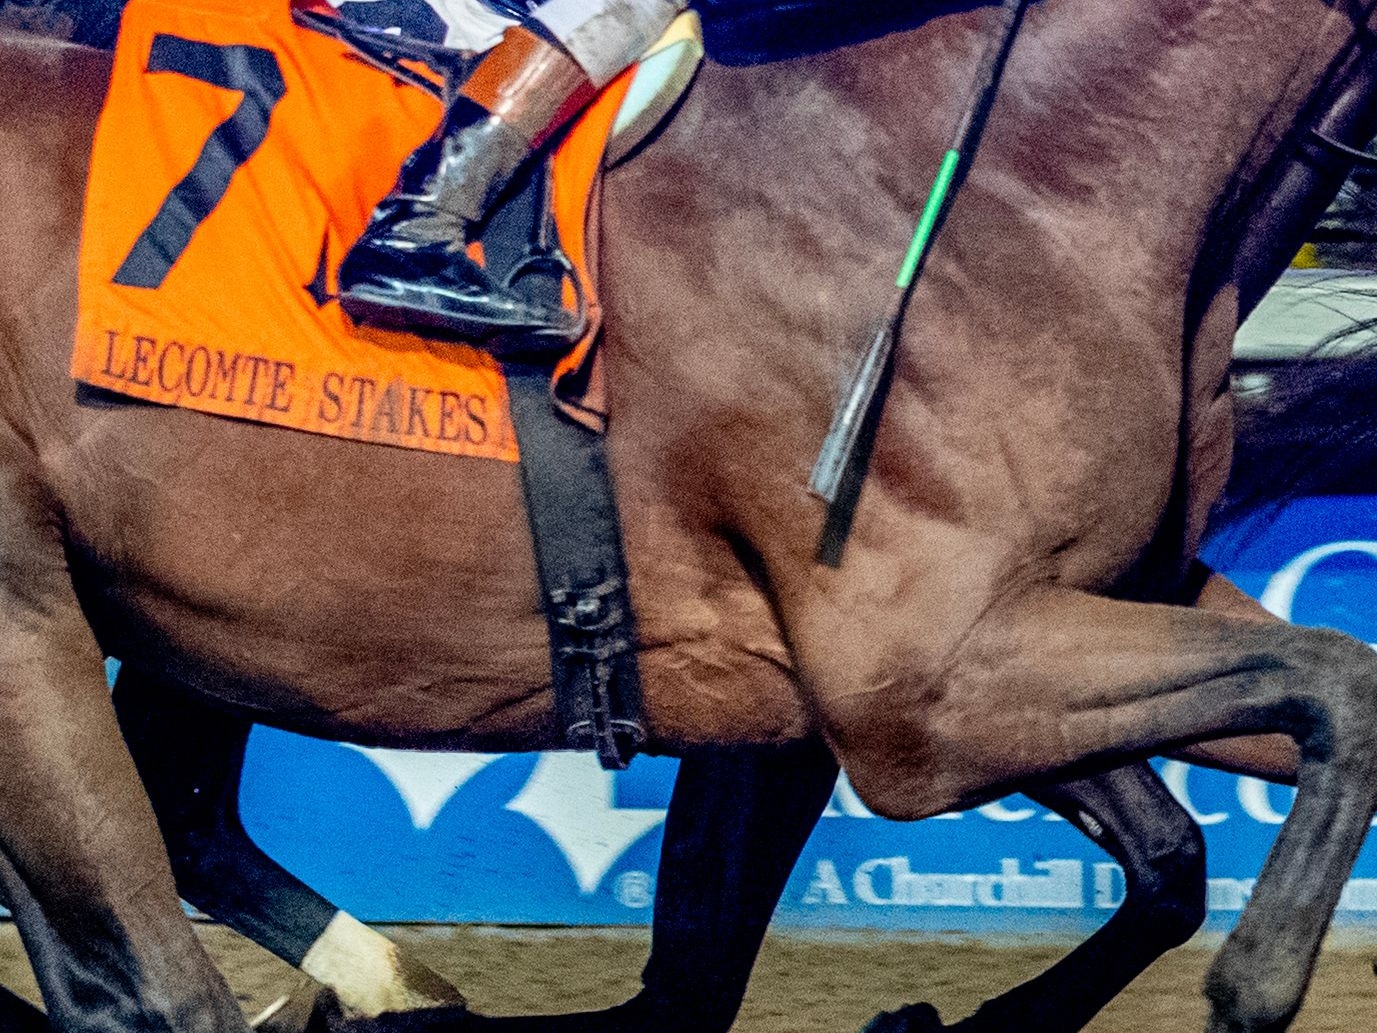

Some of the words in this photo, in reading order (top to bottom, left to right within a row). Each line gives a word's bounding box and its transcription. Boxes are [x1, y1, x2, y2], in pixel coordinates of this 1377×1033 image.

[111, 33, 288, 291] 7
[100, 329, 298, 414] LECOMTE
[317, 370, 489, 447] STAKES
[802, 859, 848, 905] A
